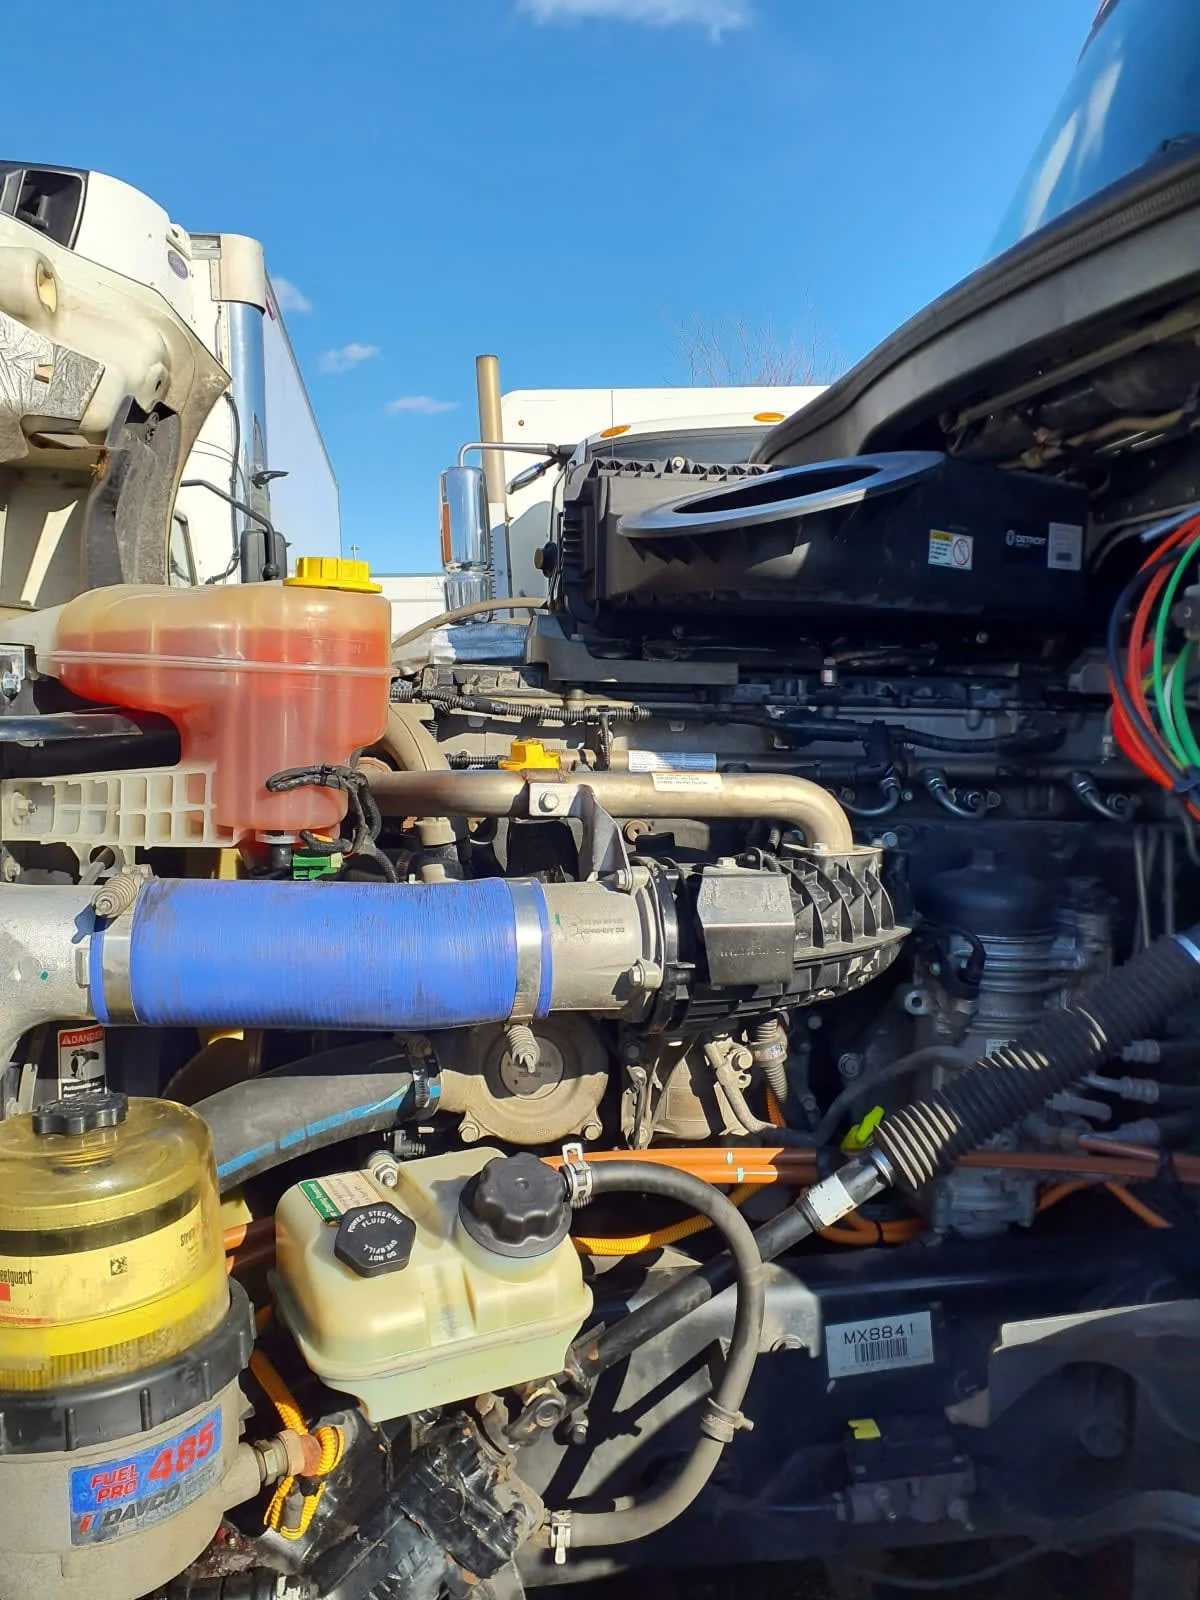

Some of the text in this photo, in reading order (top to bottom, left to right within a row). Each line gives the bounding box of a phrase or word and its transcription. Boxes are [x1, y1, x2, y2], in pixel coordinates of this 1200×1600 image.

[347, 1210, 402, 1232] POWER STEERING
[361, 1218, 386, 1228] FLUID
[363, 1239, 398, 1254] OVERFILL
[386, 1250, 397, 1259] DO
[843, 1322, 914, 1345] MX8841
[148, 1420, 216, 1482] 485
[91, 1463, 138, 1489] FUEL
[97, 1479, 138, 1504] PRO
[102, 1482, 180, 1527] DAVCO
